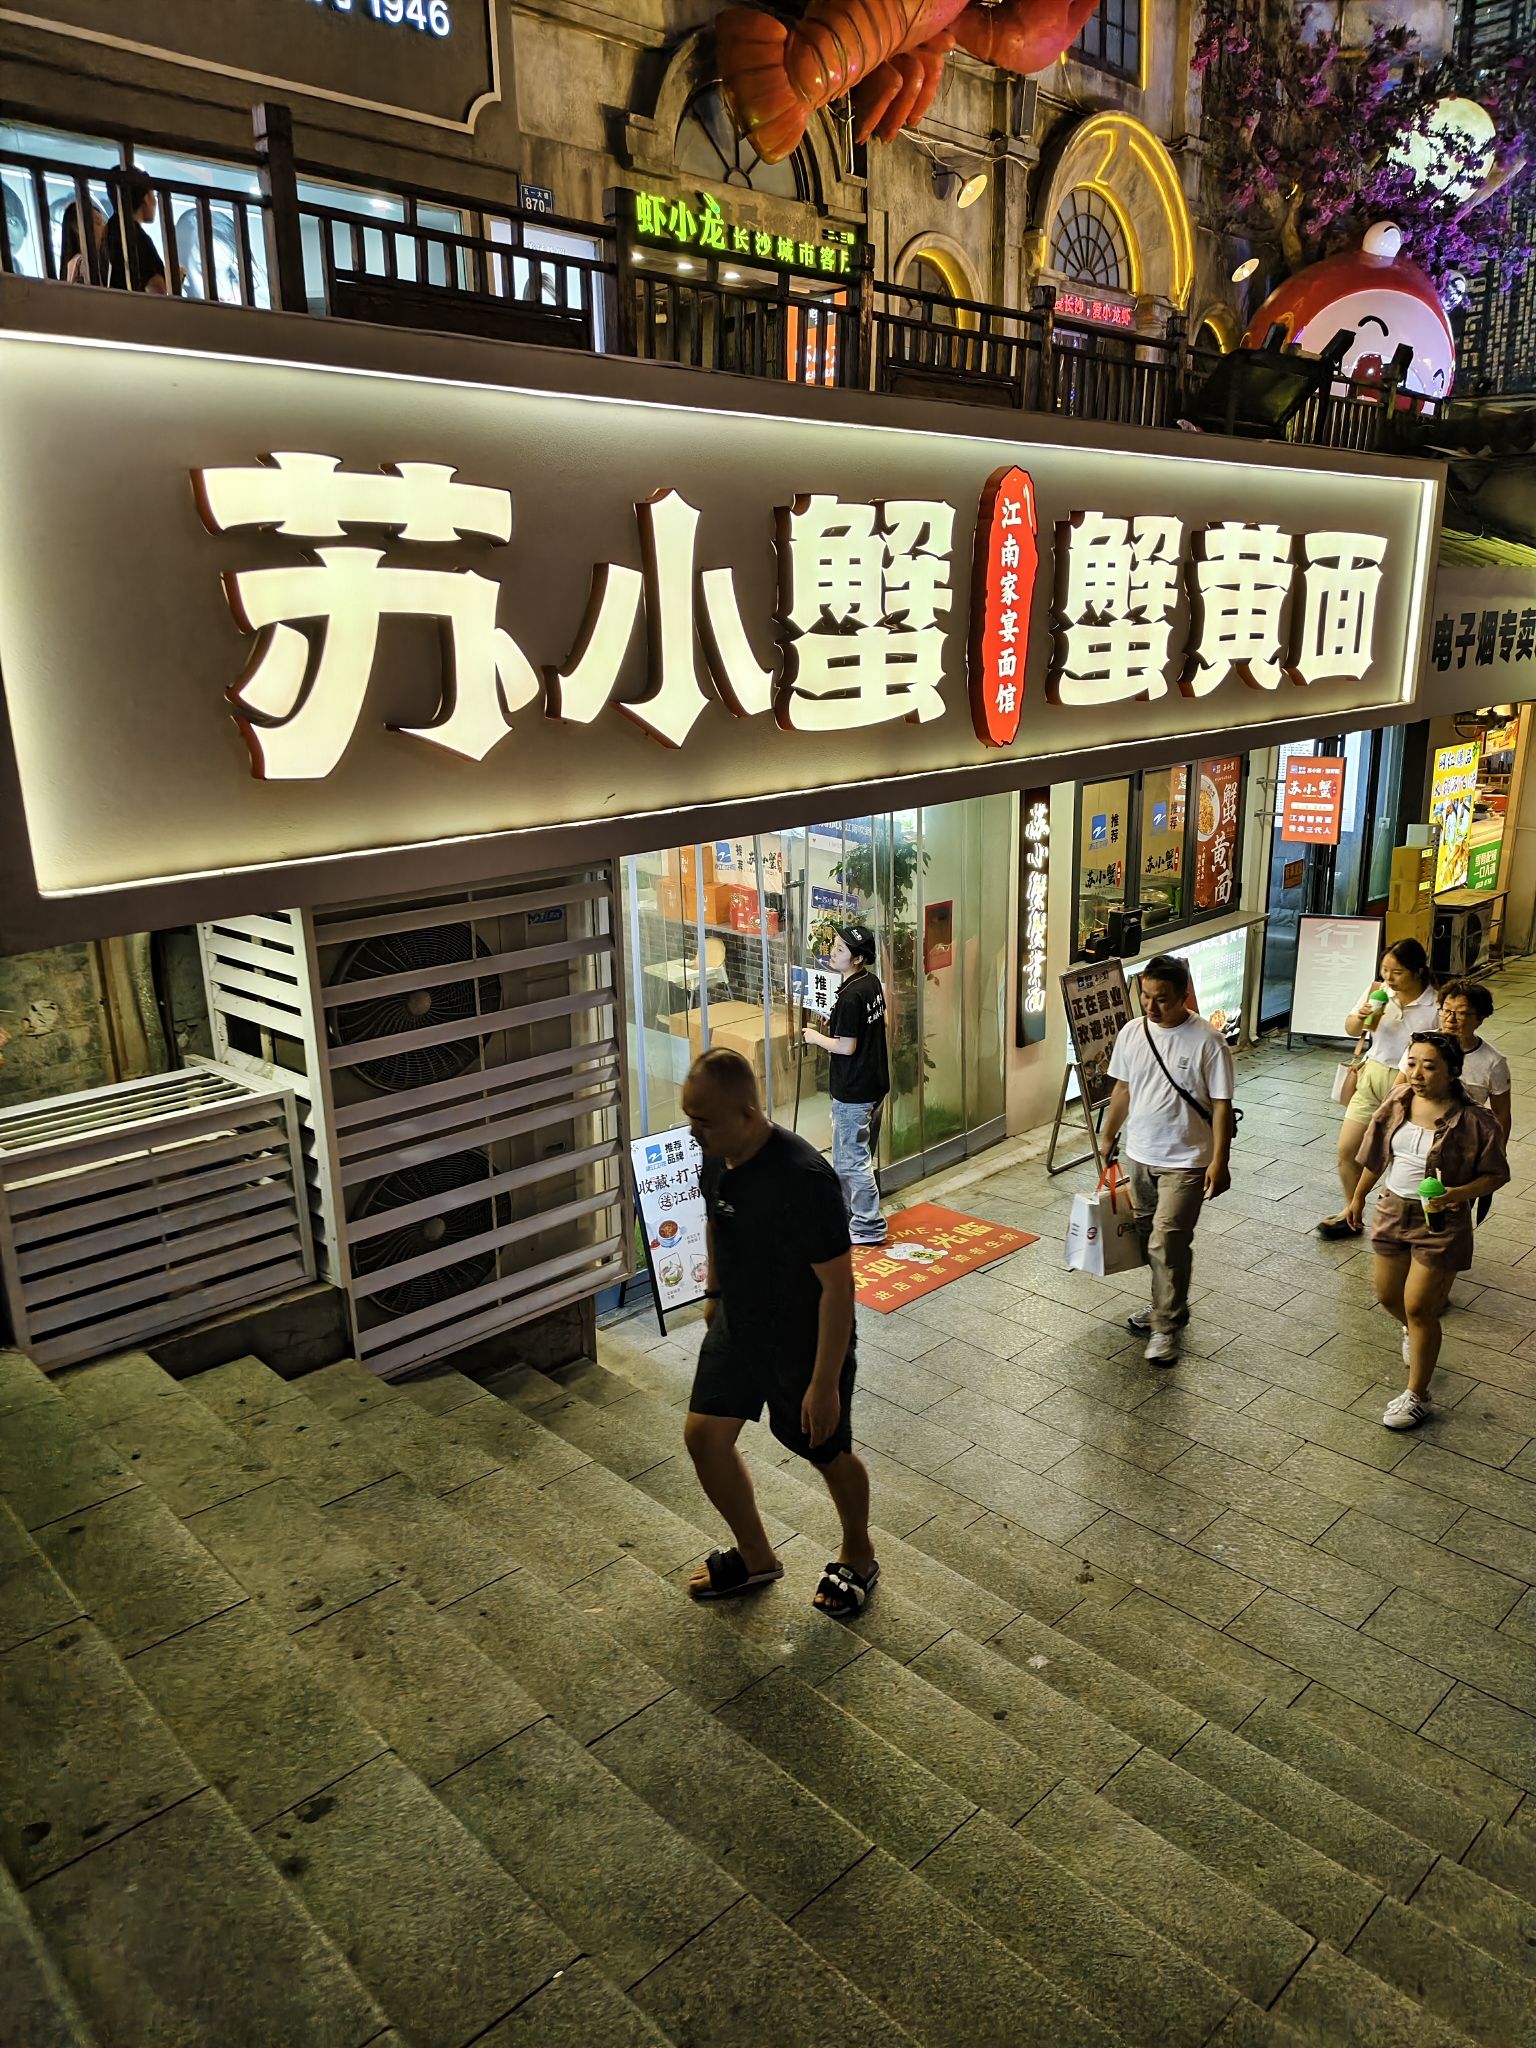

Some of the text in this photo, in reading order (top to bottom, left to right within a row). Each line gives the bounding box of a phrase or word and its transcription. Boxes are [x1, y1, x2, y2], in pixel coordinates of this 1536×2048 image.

[636, 192, 726, 250] 虾小龙
[193, 450, 957, 781] 苏小蟹
[995, 497, 1022, 714] 江南家宴面馆
[1049, 510, 1389, 705] 蟹黄面
[1288, 780, 1332, 799] 苏小蟹
[814, 973, 828, 1009] 推荐
[664, 1139, 683, 1154] 推荐
[666, 1150, 685, 1165] 品牌
[852, 1226, 930, 1262] WELOME
[926, 1221, 994, 1249] 光临
